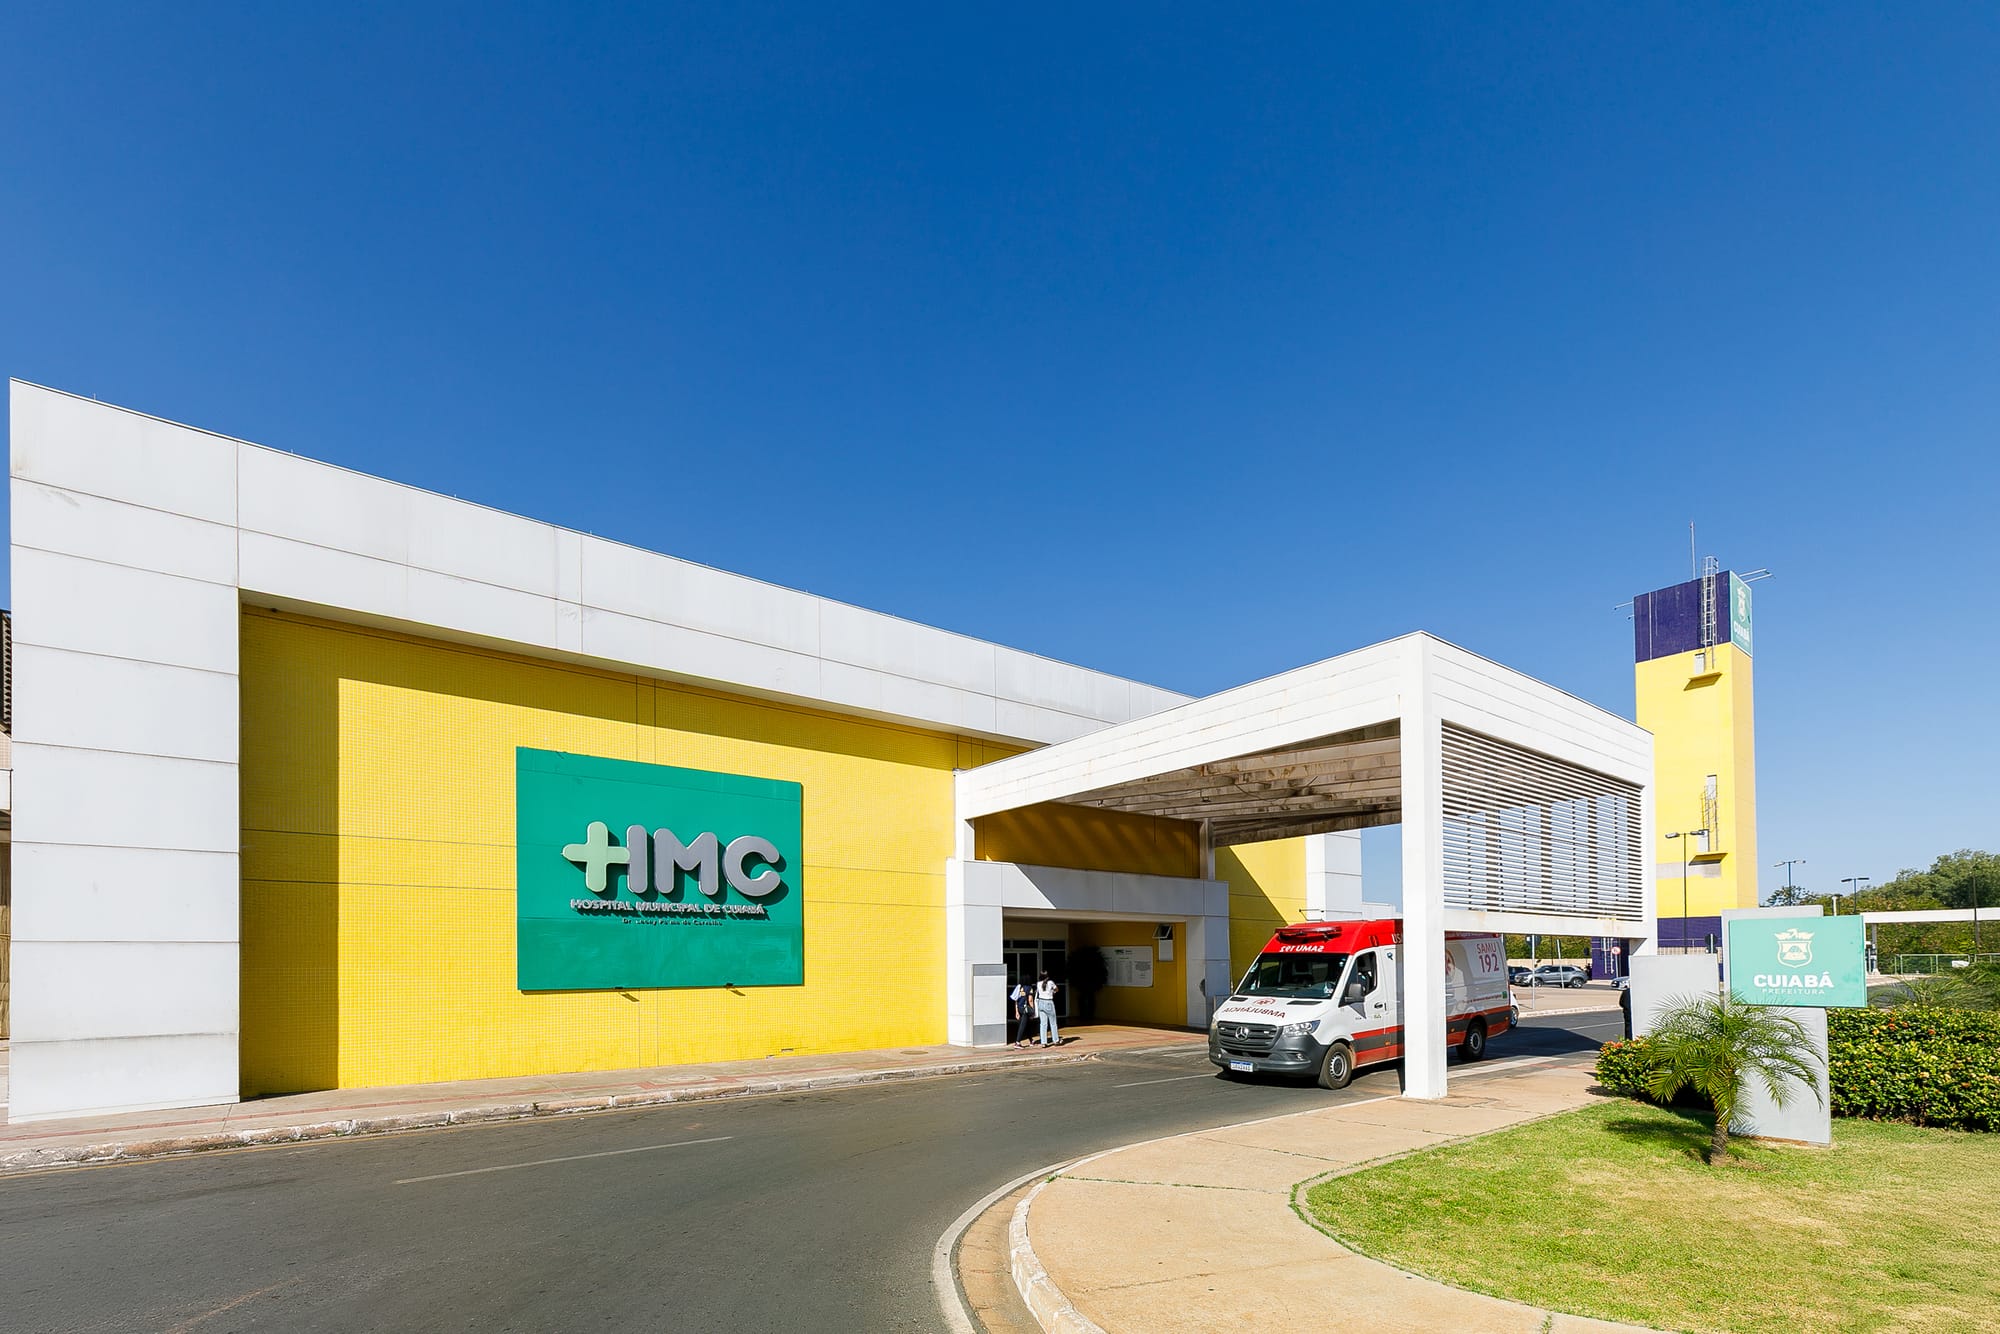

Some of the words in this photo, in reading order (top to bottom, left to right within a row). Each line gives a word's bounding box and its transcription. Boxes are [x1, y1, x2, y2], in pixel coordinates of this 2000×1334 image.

[570, 899, 633, 911] HOSPITAL
[635, 901, 702, 913] MUNICIPAL
[704, 904, 720, 913] DE
[722, 904, 765, 914] CUIABÁ
[1476, 942, 1497, 954] SAMU
[1479, 953, 1499, 973] 192
[1753, 971, 1834, 988] CUIABÁ
